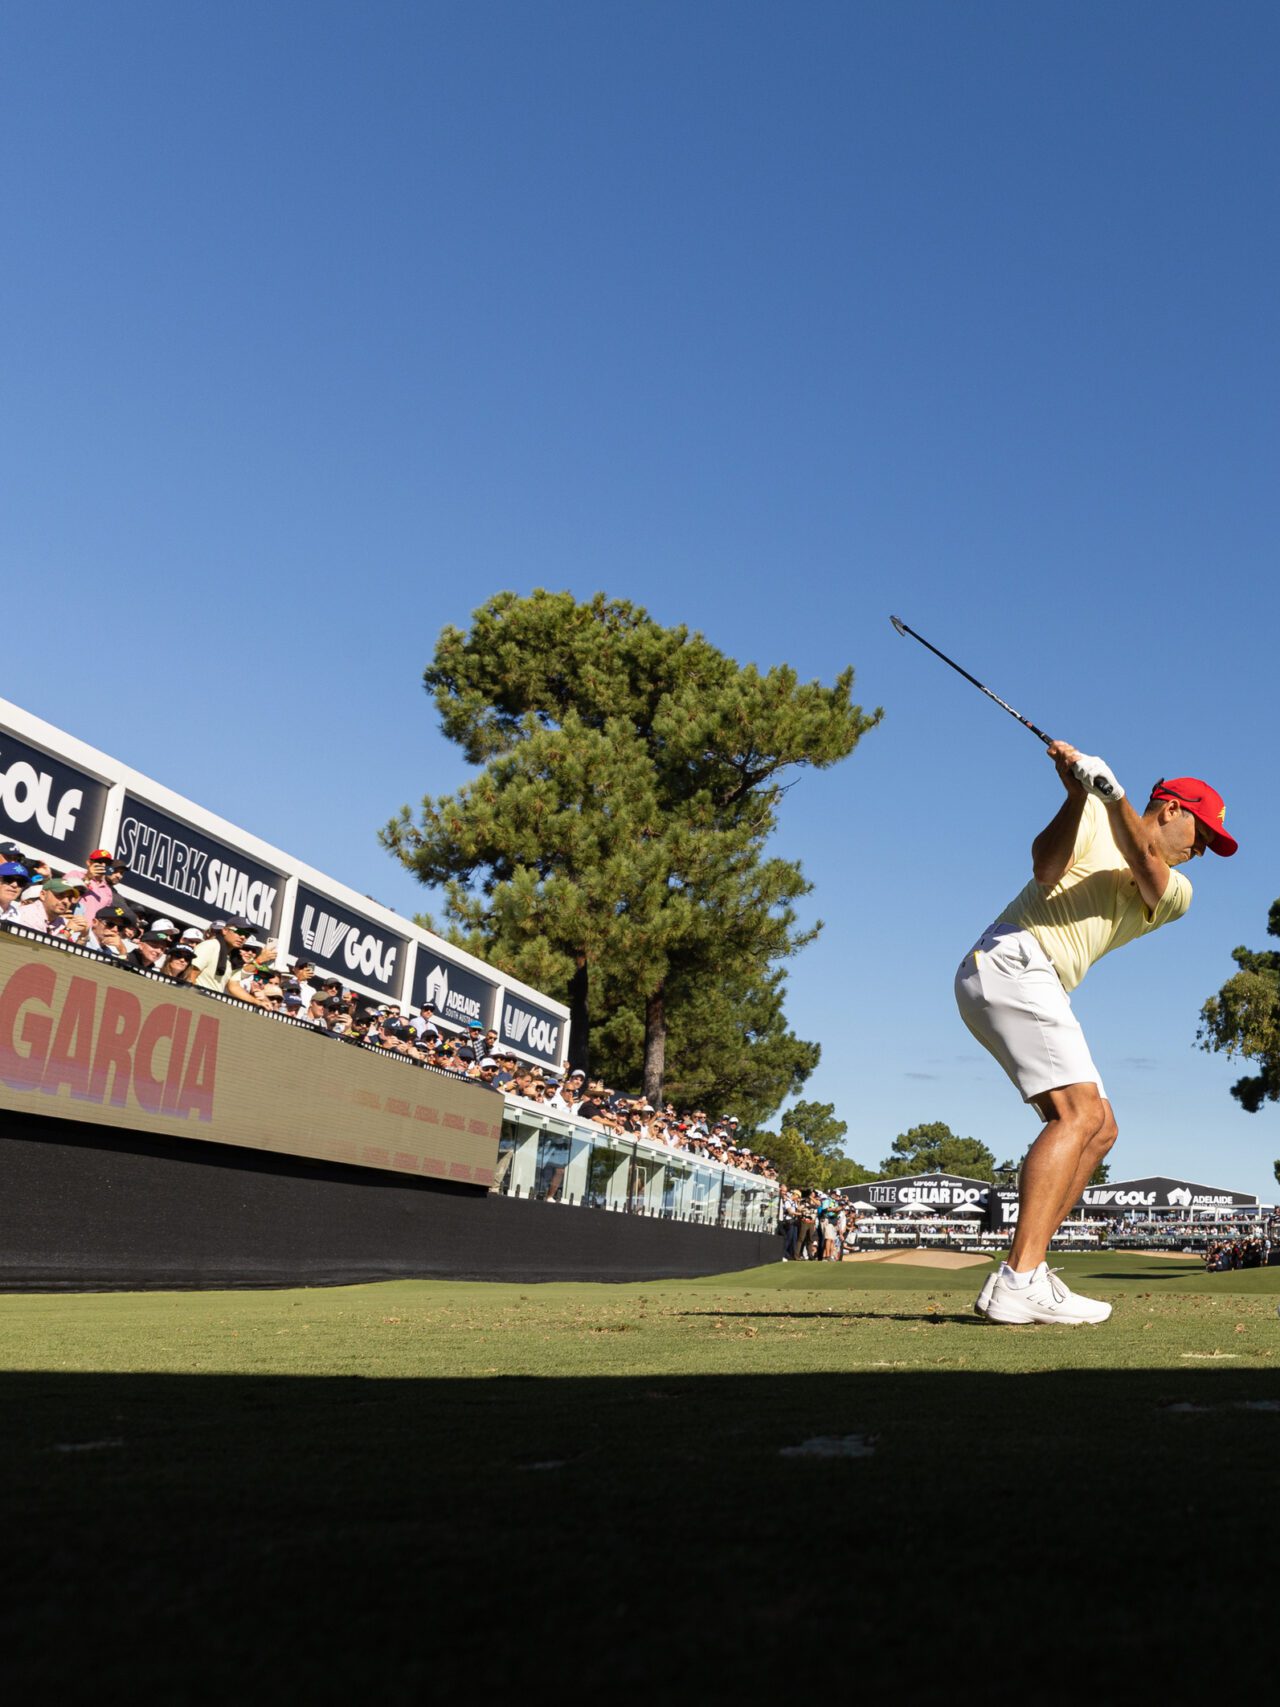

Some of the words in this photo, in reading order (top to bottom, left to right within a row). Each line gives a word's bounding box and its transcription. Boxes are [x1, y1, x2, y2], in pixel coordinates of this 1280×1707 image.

[0, 757, 83, 841] OLF
[117, 817, 208, 900] SHARK
[204, 858, 277, 930] SHACK
[301, 904, 350, 959] LIV
[344, 927, 397, 984] GOLF
[446, 989, 481, 1020] ADELAIDE
[0, 963, 220, 1123] GARCIA
[504, 1004, 532, 1042] LIV
[527, 1016, 558, 1055] GOLF
[869, 1186, 896, 1203] THE
[898, 1187, 950, 1203] CELLAR
[1001, 1202, 1018, 1222] 12
[1082, 1190, 1117, 1205] LIV
[1115, 1191, 1156, 1205] GOLF
[1193, 1195, 1233, 1204] ADELAIDE
